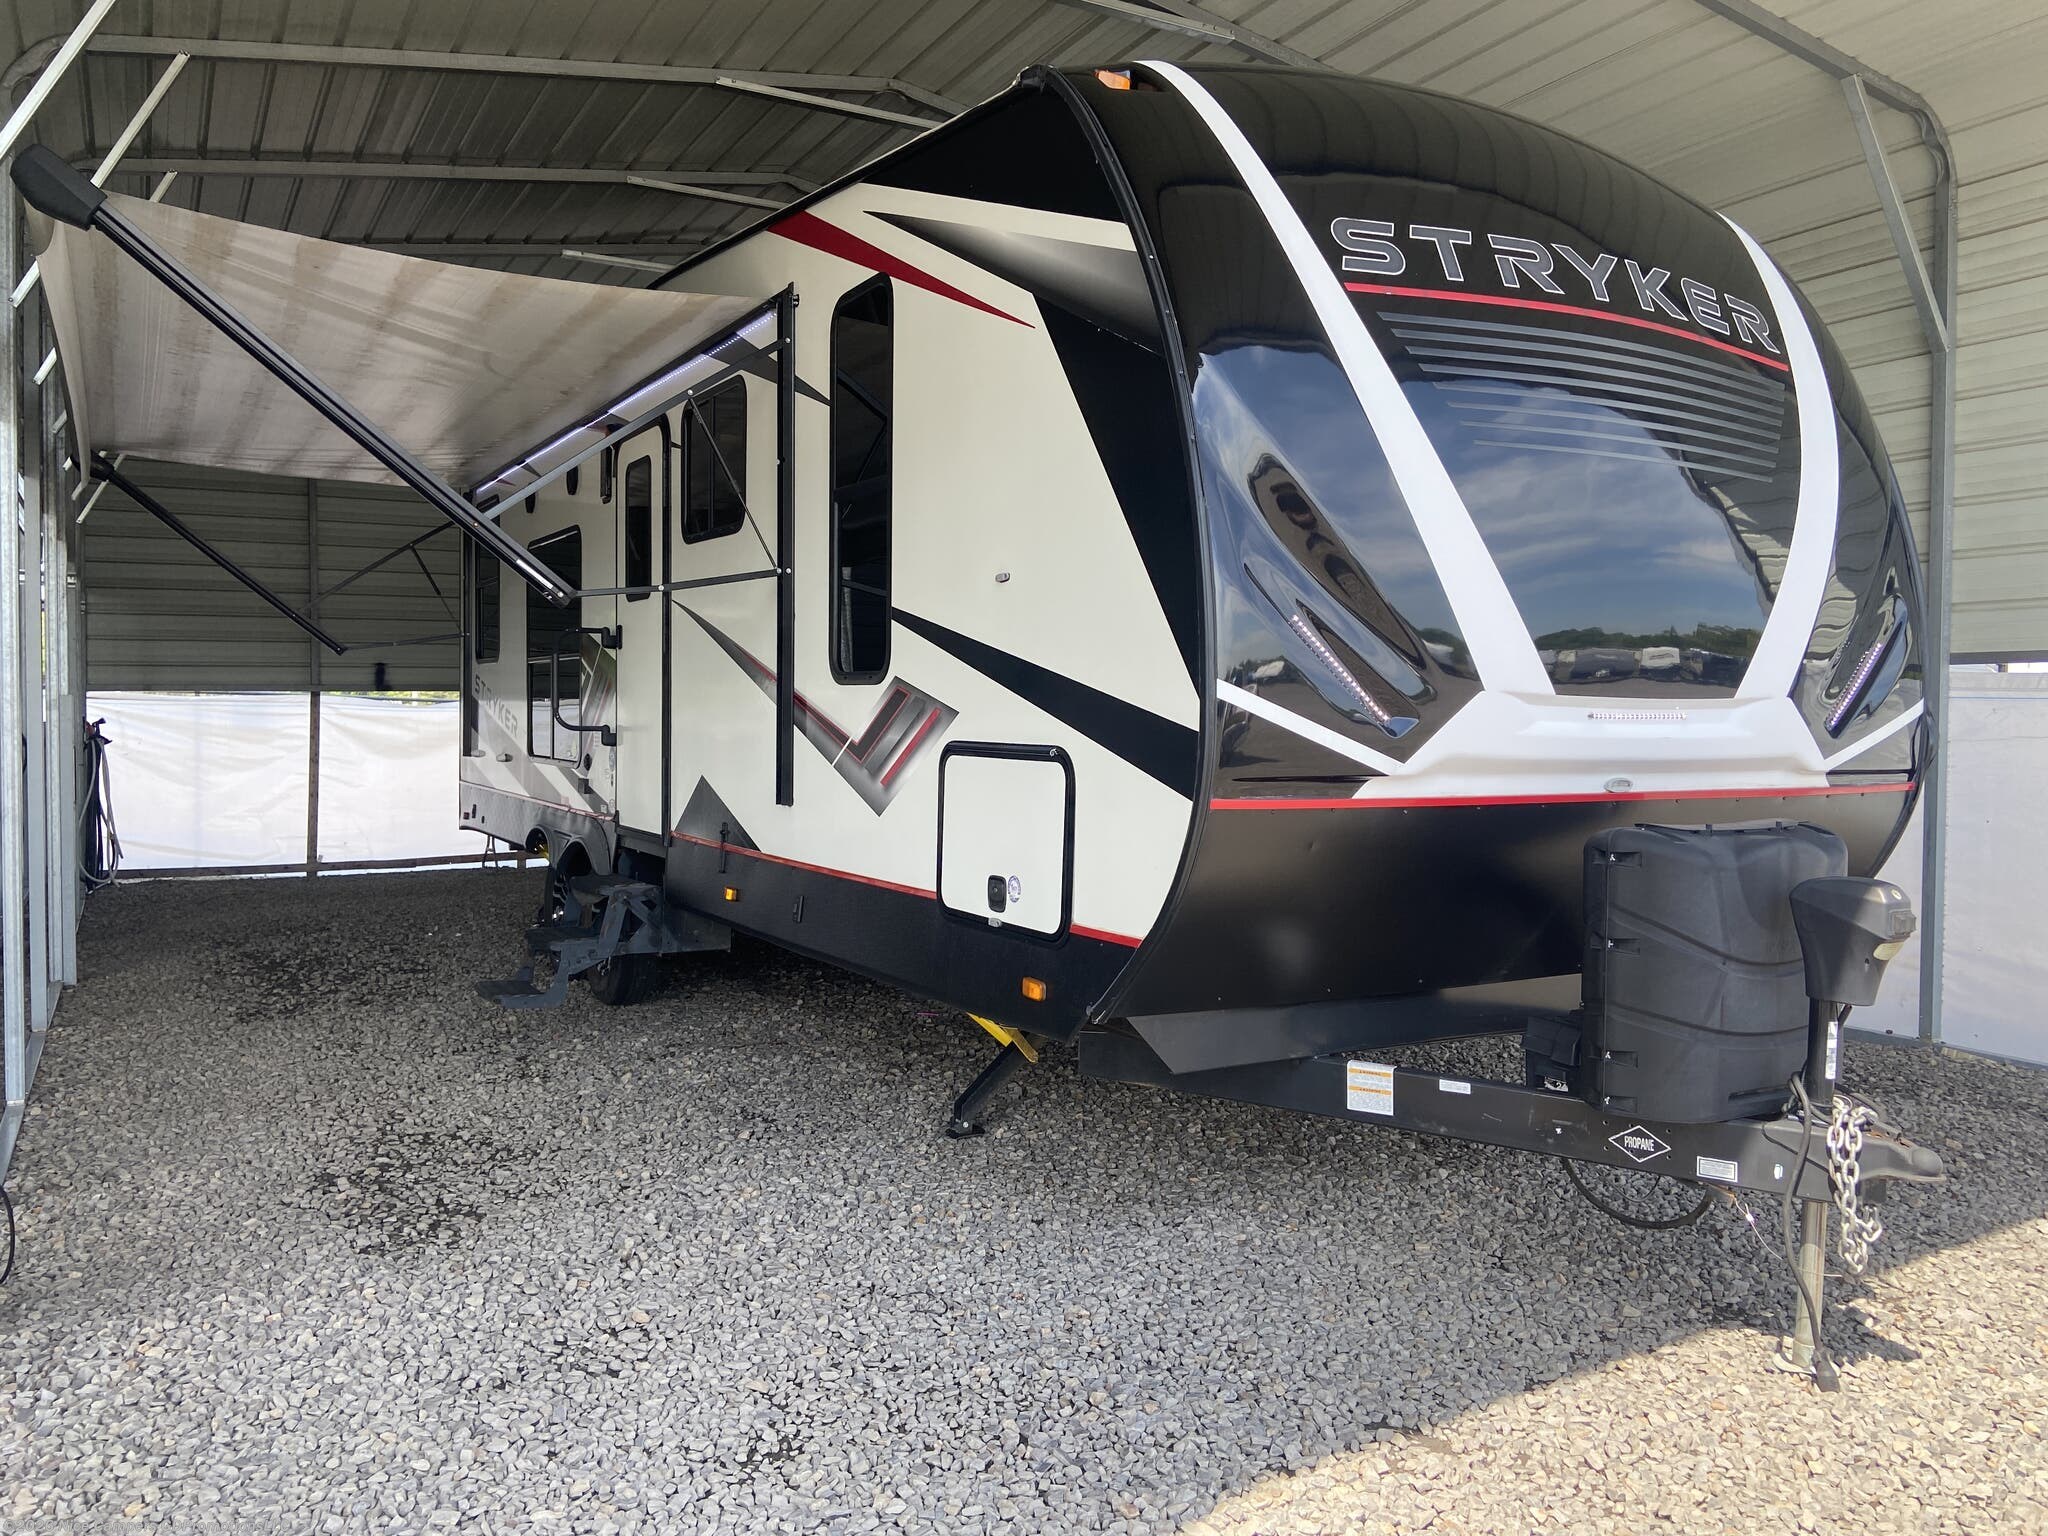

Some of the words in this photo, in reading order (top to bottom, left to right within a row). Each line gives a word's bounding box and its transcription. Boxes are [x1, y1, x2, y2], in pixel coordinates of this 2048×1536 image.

[1330, 216, 1781, 354] STRYKER
[474, 674, 518, 736] STRYKER
[1624, 1135, 1655, 1152] PROPANE
